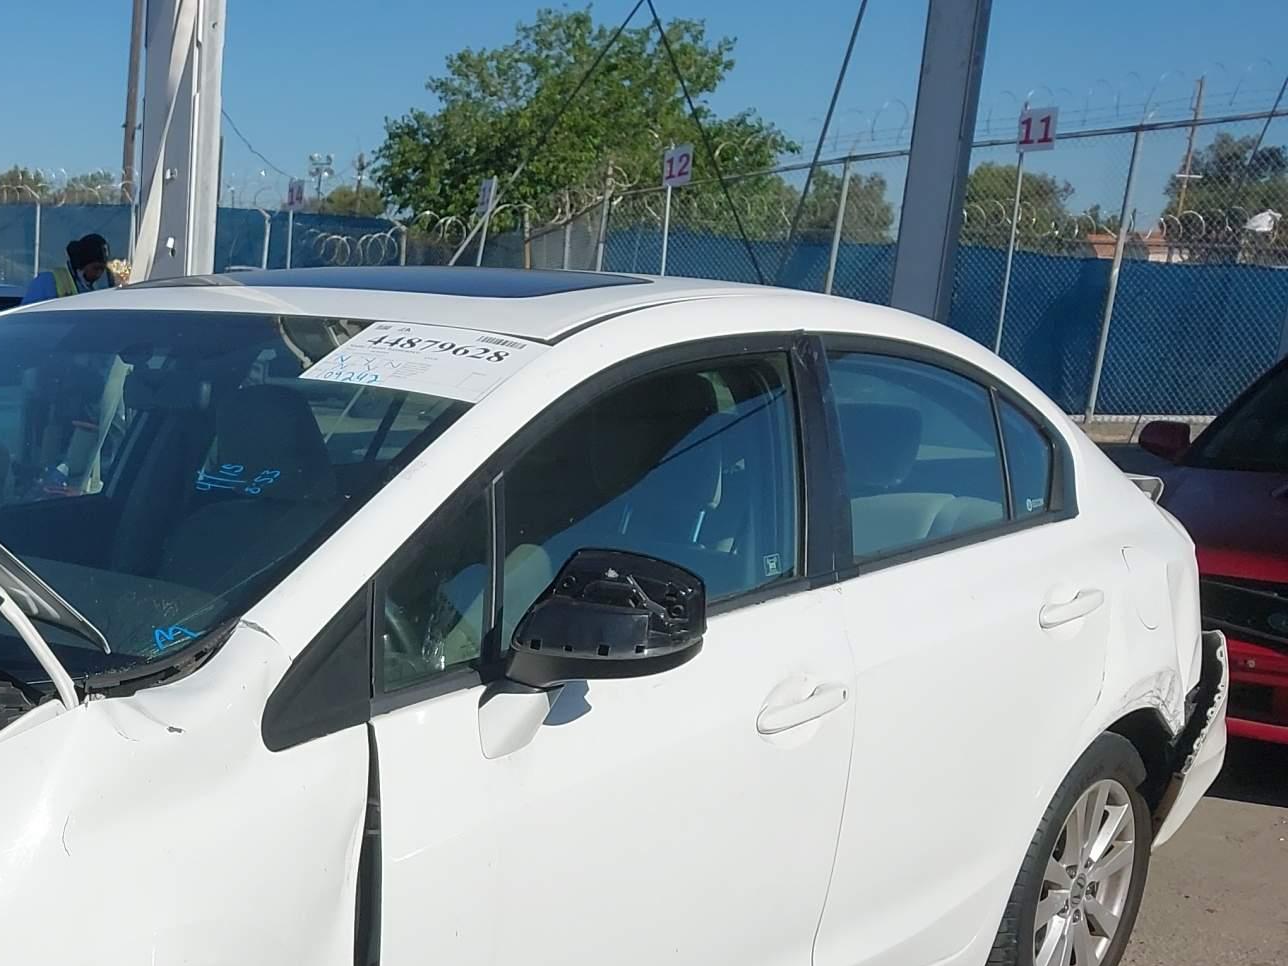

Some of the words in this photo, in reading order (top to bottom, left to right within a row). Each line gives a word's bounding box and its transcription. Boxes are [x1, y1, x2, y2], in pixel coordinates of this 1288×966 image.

[1018, 114, 1053, 145] 11
[664, 152, 690, 180] 12
[367, 334, 510, 363] 44879628
